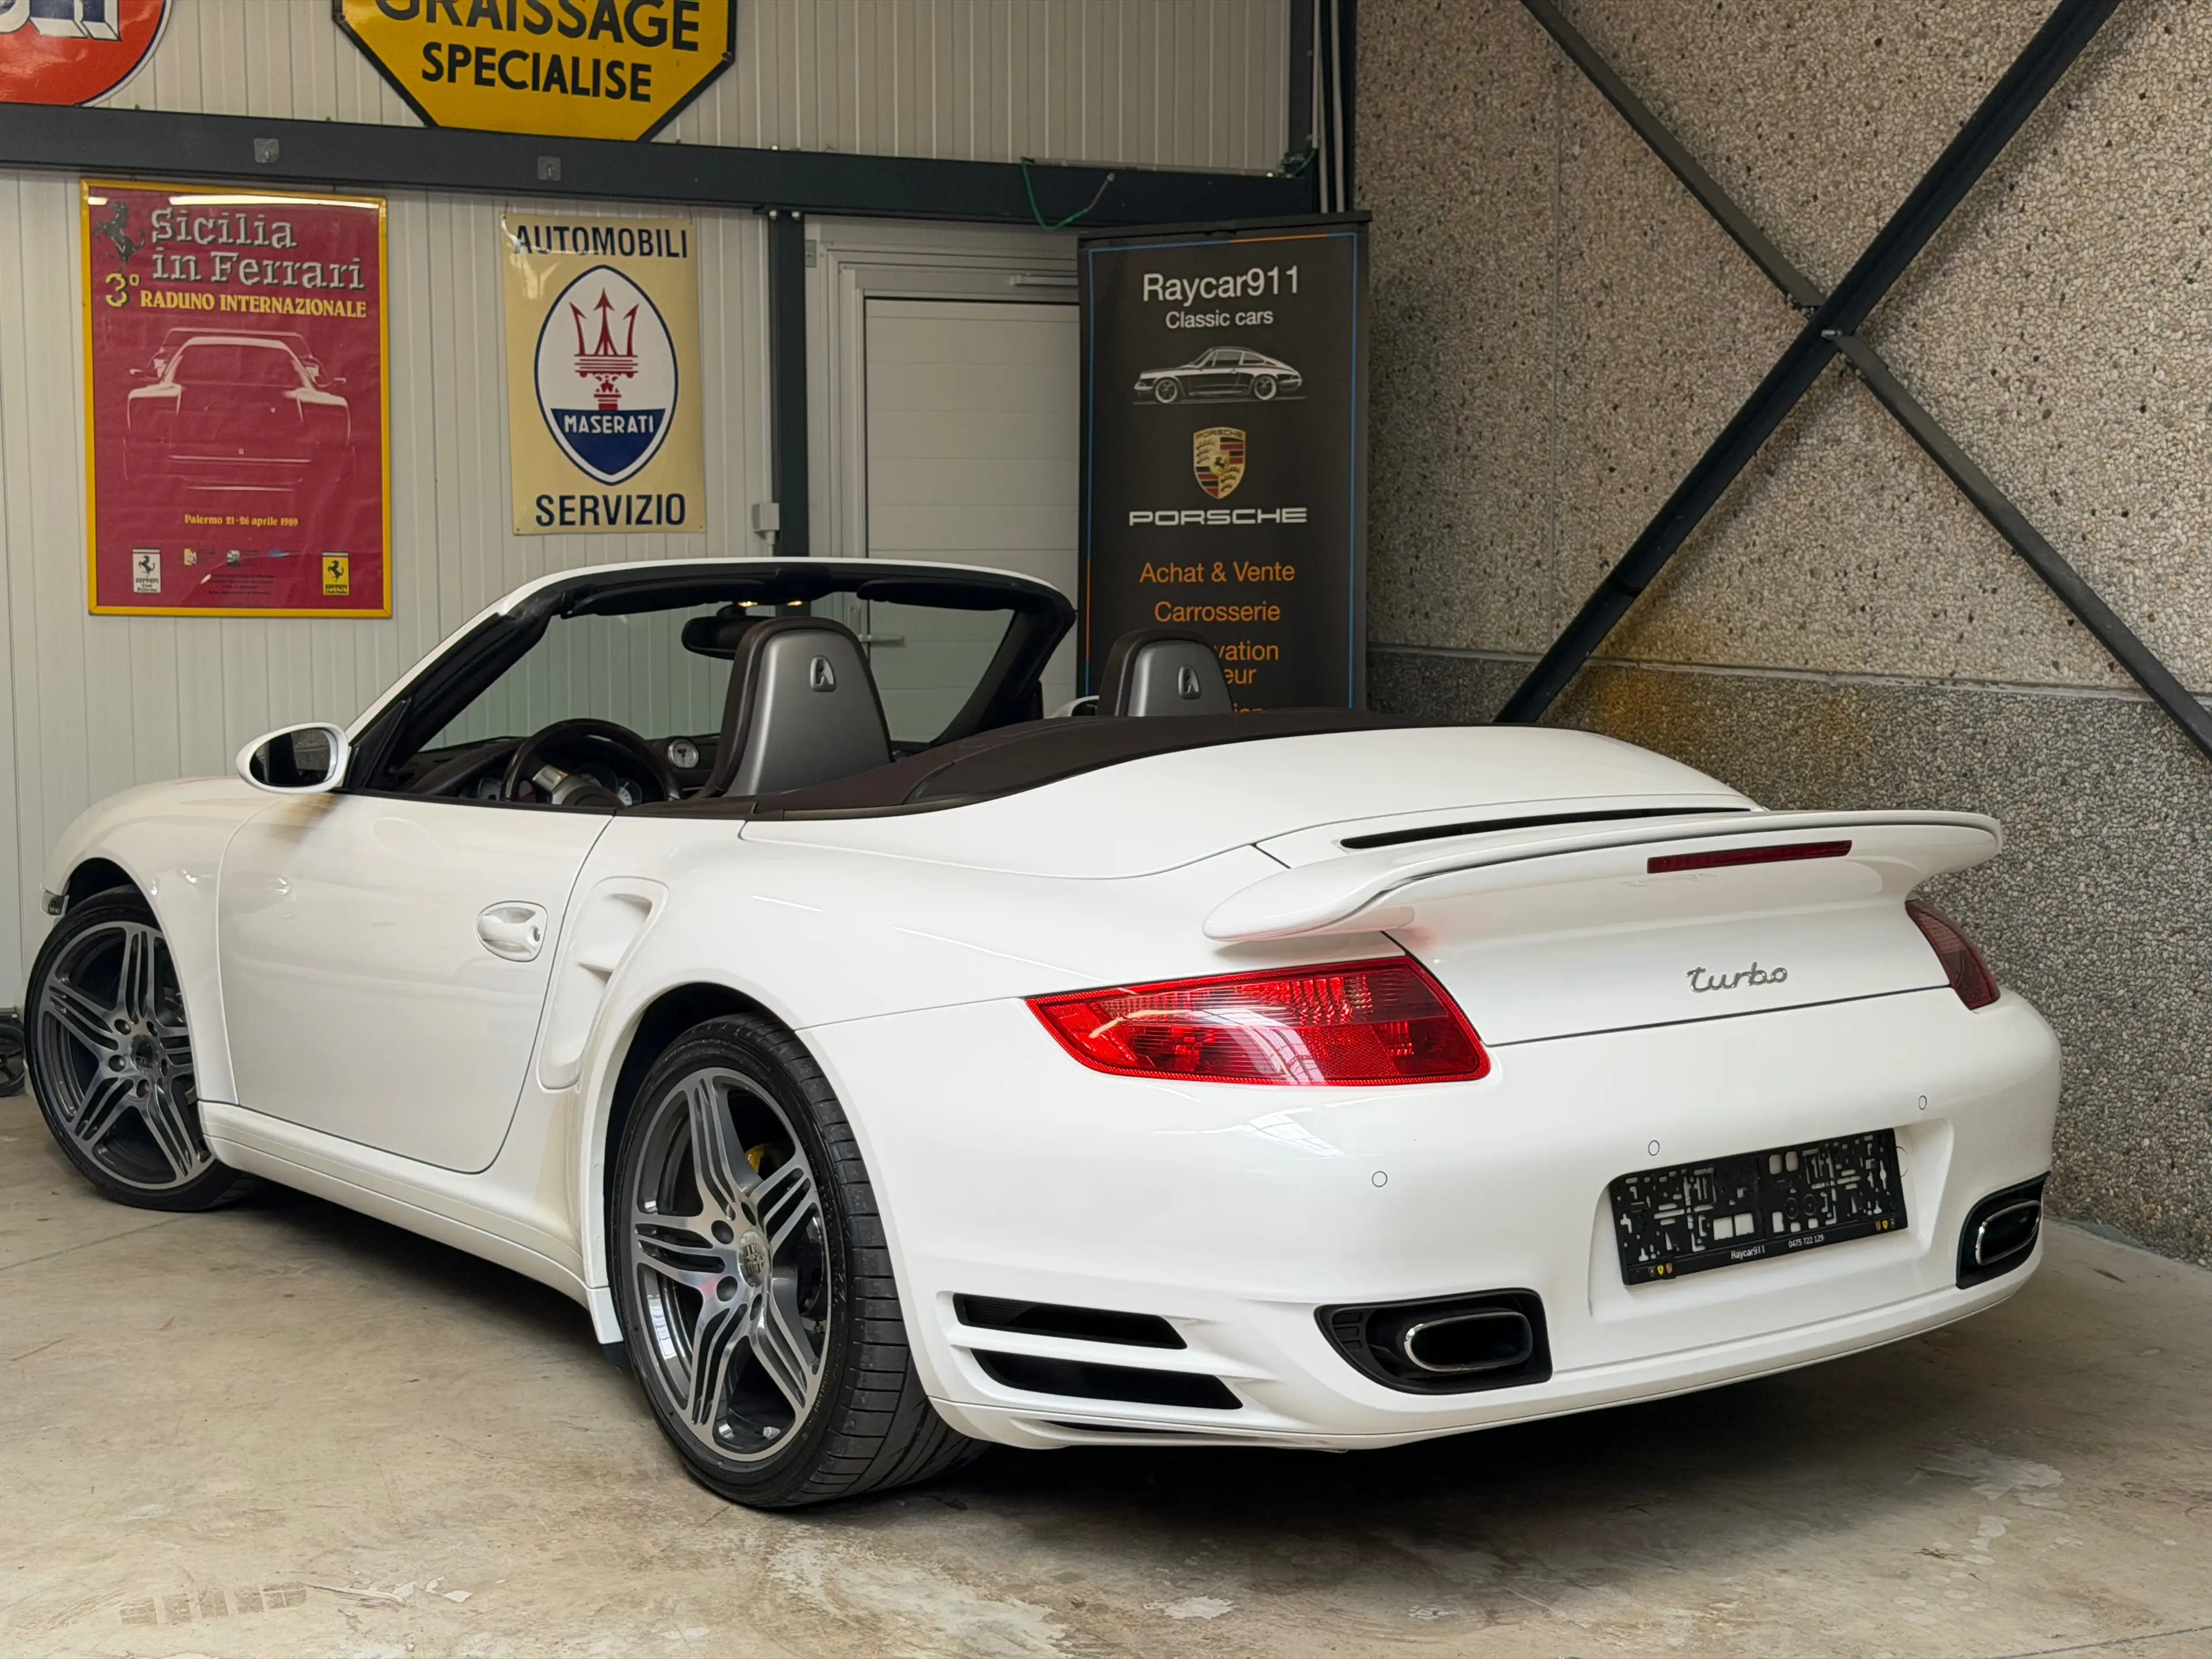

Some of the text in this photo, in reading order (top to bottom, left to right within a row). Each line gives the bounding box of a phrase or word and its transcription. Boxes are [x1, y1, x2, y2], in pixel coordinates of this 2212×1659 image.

[422, 41, 653, 103] SPECIALISE
[151, 207, 298, 249] Sicilia
[514, 225, 688, 258] AUTOMOBILI
[152, 247, 365, 290] in Ferrari
[1142, 265, 1299, 307] Raycar911
[141, 290, 215, 310] RADUNO
[220, 294, 367, 319] INTERNAZIONALE
[1165, 309, 1274, 329] Classic cars
[563, 415, 654, 434] MASERATI
[184, 514, 223, 524] Palermo
[251, 517, 278, 527] aprile
[535, 494, 686, 527] SERVIZIO
[1128, 507, 1308, 526] PORSCHE
[1139, 560, 1296, 583] Achat & Vente
[1154, 600, 1281, 623] Carrosserie
[1213, 639, 1279, 661] vation
[1224, 668, 1257, 684] eur
[1685, 961, 1788, 993] turbo
[1730, 1244, 1766, 1260] Raycar911
[1788, 1238, 1802, 1248] 0475
[1814, 1233, 1824, 1243] 129
